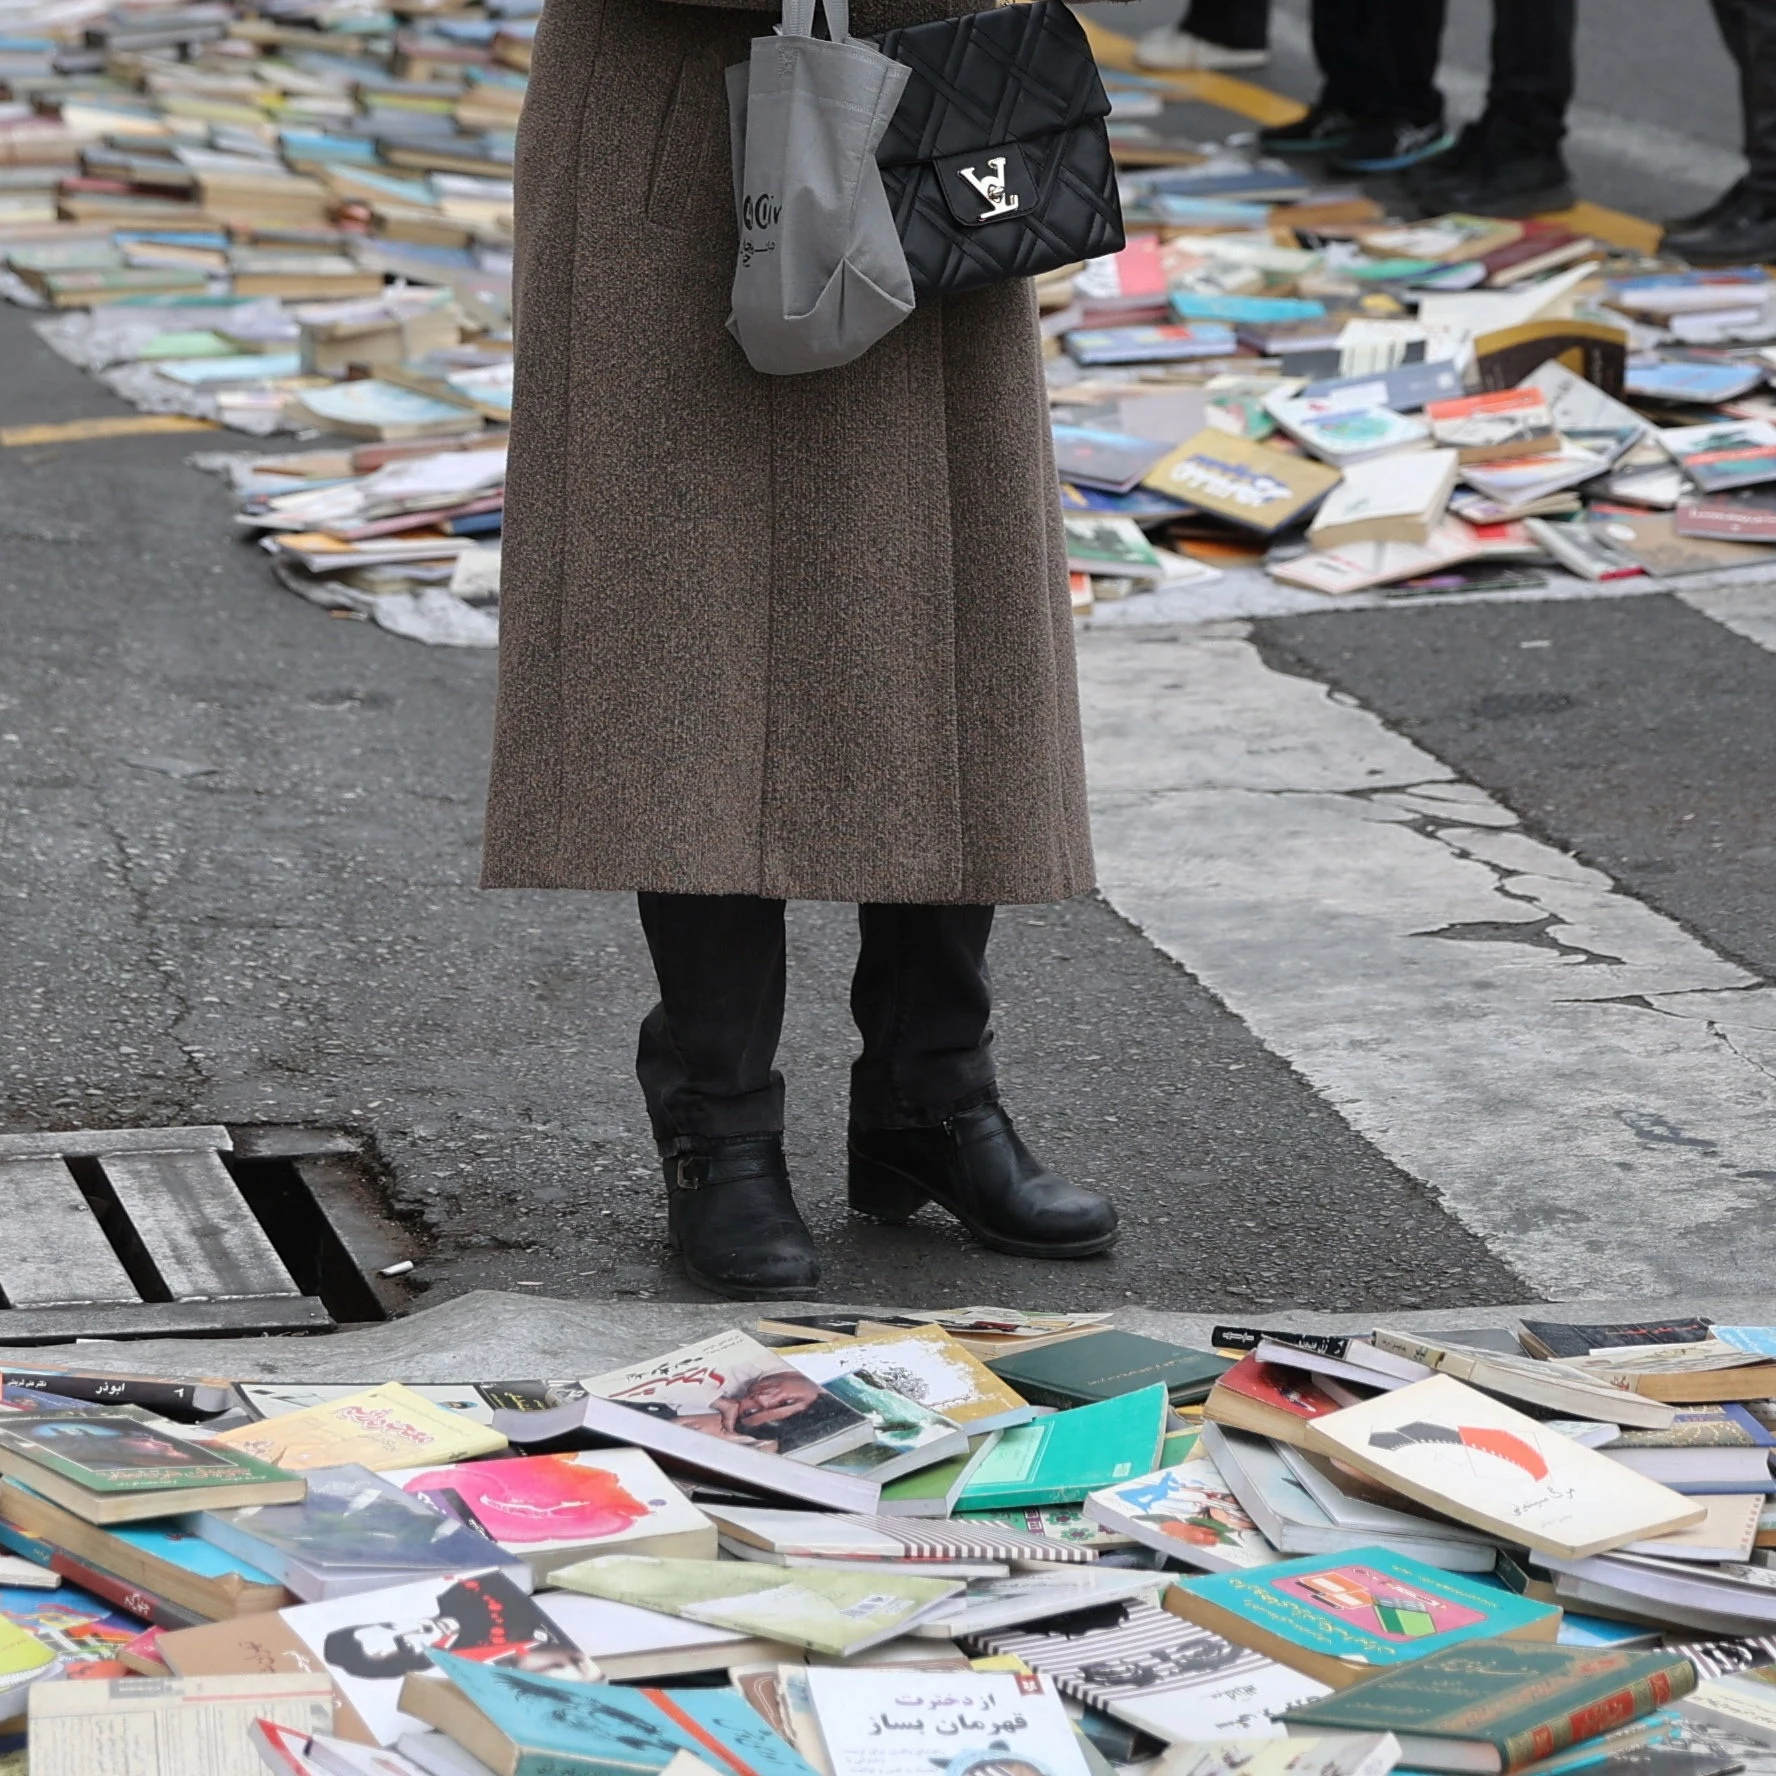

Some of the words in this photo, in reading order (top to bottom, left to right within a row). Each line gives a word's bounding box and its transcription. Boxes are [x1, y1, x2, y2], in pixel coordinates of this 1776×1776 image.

[95, 1382, 126, 1397] ابوذر
[894, 1692, 974, 1711] دخترت
[979, 1693, 997, 1711] از
[868, 1712, 926, 1737] بساز
[935, 1711, 1028, 1737] قهرمان
